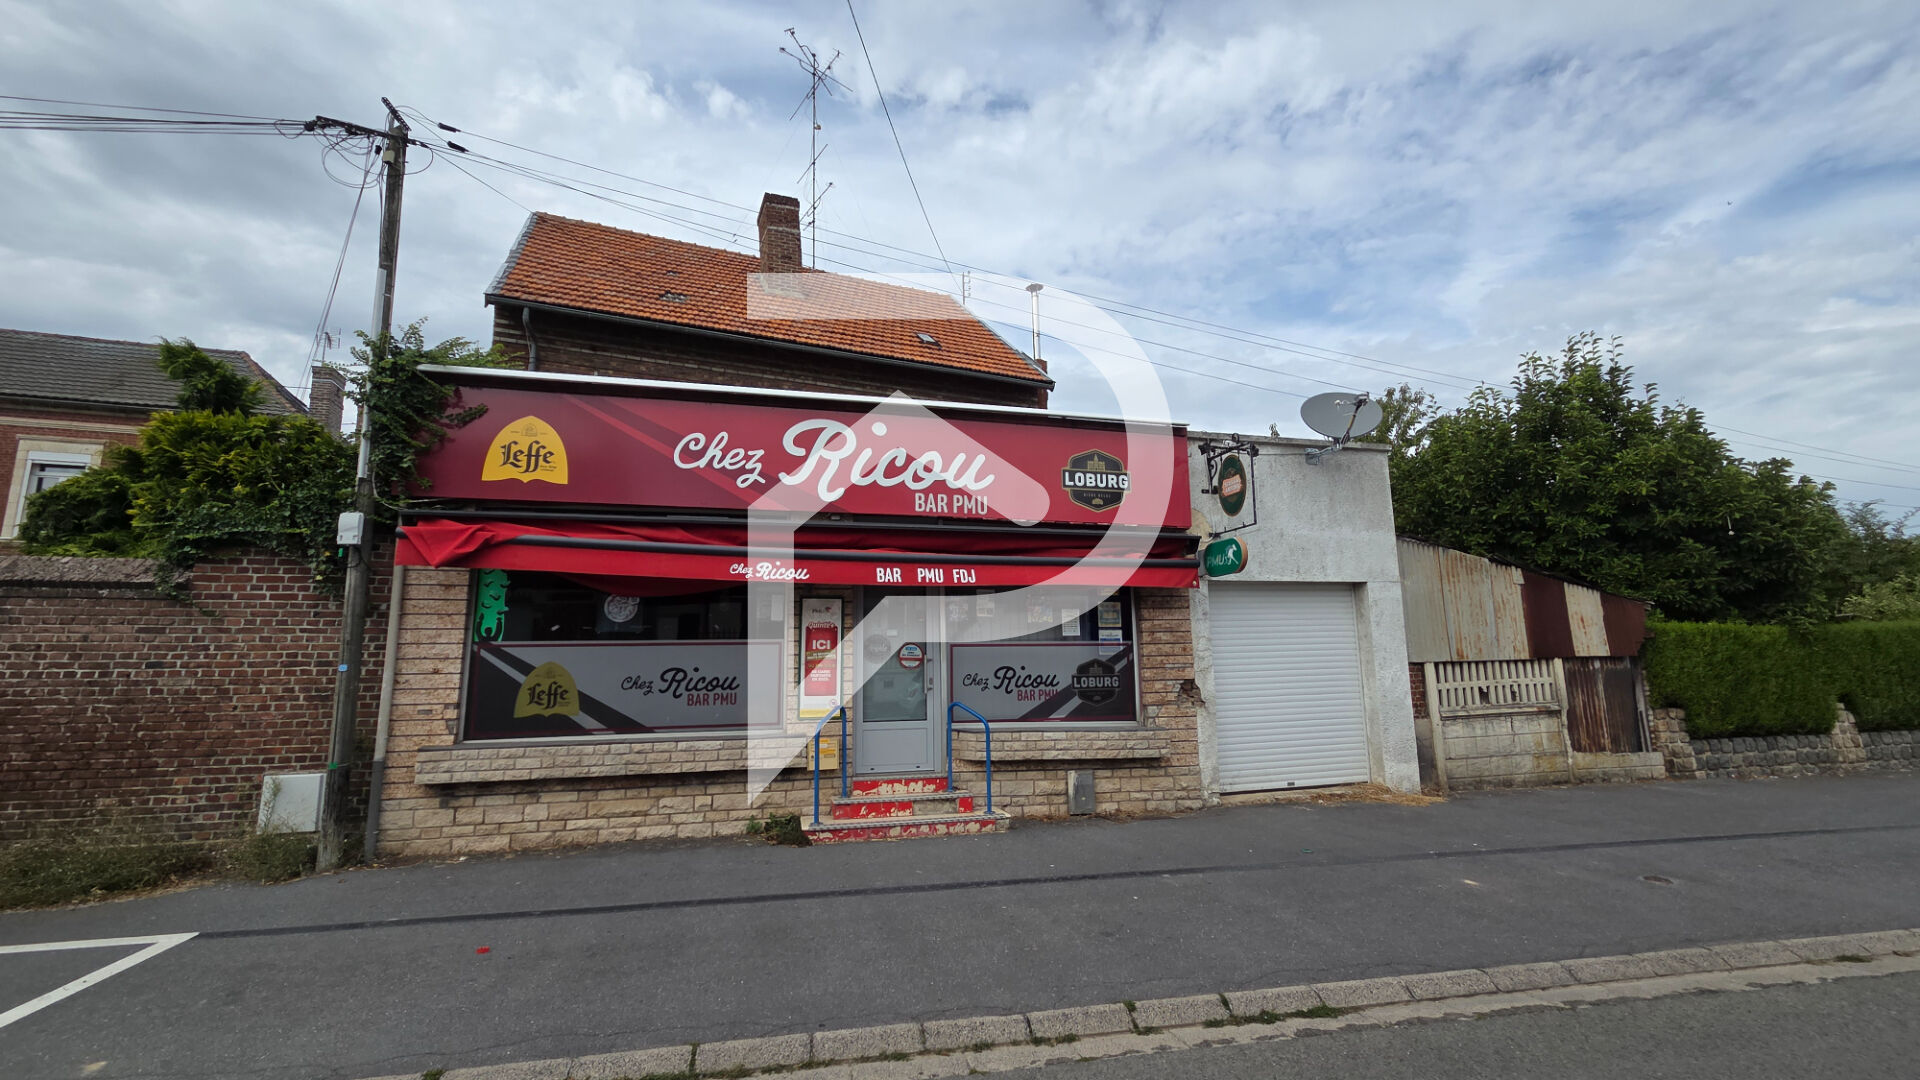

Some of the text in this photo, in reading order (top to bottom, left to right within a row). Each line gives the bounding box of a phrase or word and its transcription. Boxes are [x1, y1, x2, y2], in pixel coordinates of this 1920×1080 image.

[499, 440, 555, 474] Leffe
[673, 418, 995, 502] Chez Ricou
[1064, 472, 1129, 489] LOBURG
[914, 492, 988, 515] BAR PMU
[729, 561, 810, 580] Chez Ricou
[876, 567, 976, 583] BAR PMU FDJ
[812, 640, 831, 650] ICI
[621, 667, 740, 699] Chez Ricou
[963, 666, 1060, 694] Chez Ricou
[1073, 677, 1119, 688] LOBURG
[527, 681, 569, 710] Leffe
[687, 692, 737, 706] BAR PMU
[1017, 689, 1036, 701] BAR
